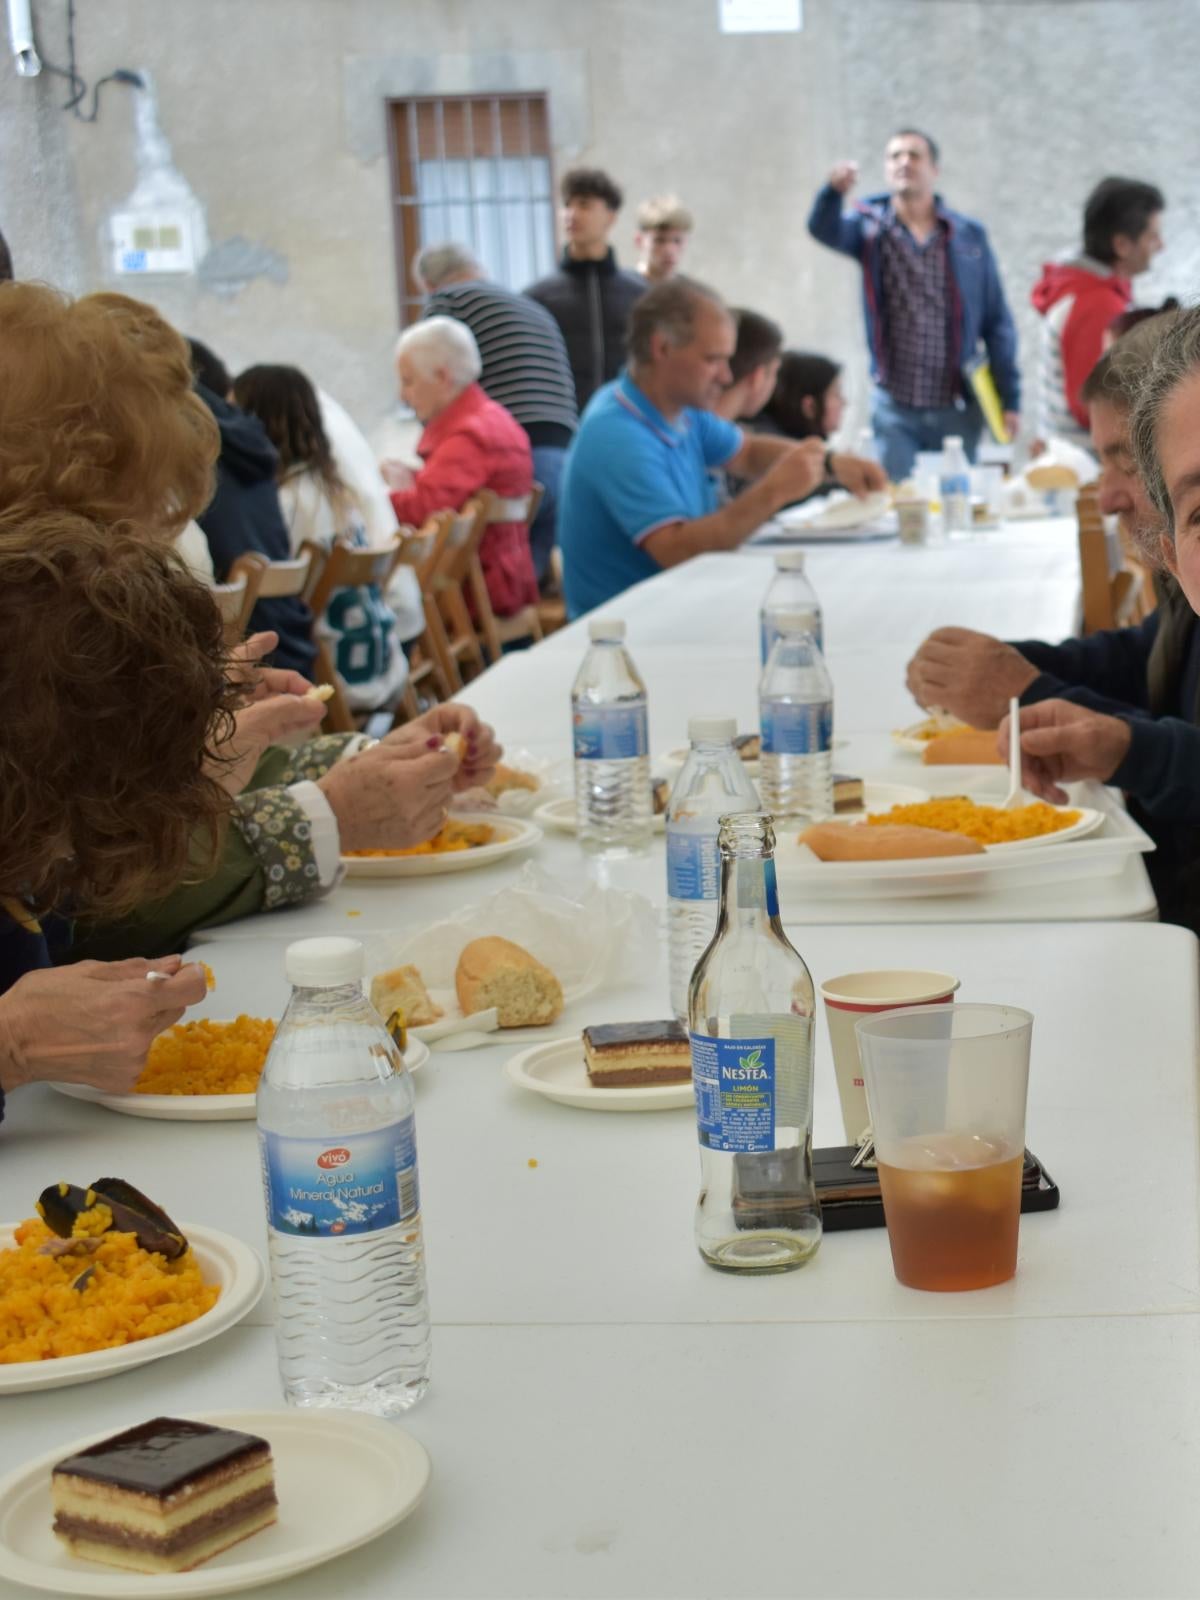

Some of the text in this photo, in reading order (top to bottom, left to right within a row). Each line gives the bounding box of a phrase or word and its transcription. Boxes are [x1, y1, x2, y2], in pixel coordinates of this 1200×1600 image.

[722, 1066, 768, 1080] NESTEA
[316, 1173, 354, 1186] Agua
[290, 1181, 384, 1201] Mineral Natural
